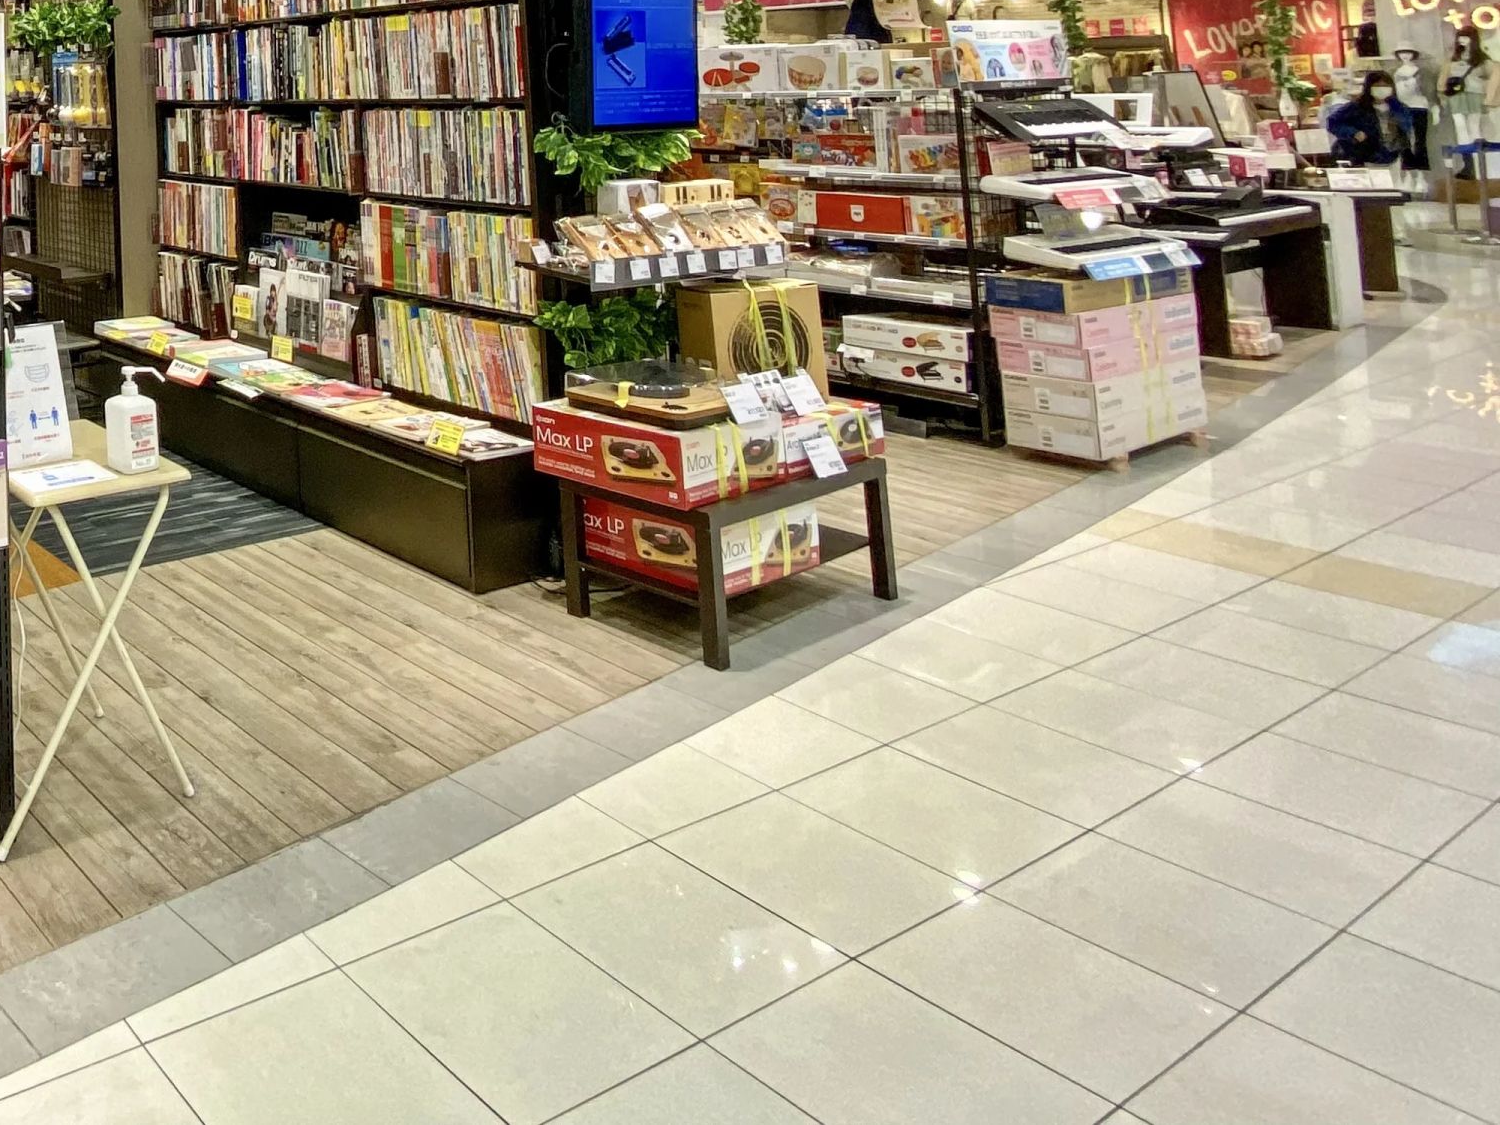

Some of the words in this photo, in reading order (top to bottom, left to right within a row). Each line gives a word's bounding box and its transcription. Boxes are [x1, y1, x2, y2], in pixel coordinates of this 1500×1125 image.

[536, 425, 570, 448] Max
[576, 434, 594, 453] LP
[686, 453, 712, 472] Max
[606, 518, 625, 535] LP
